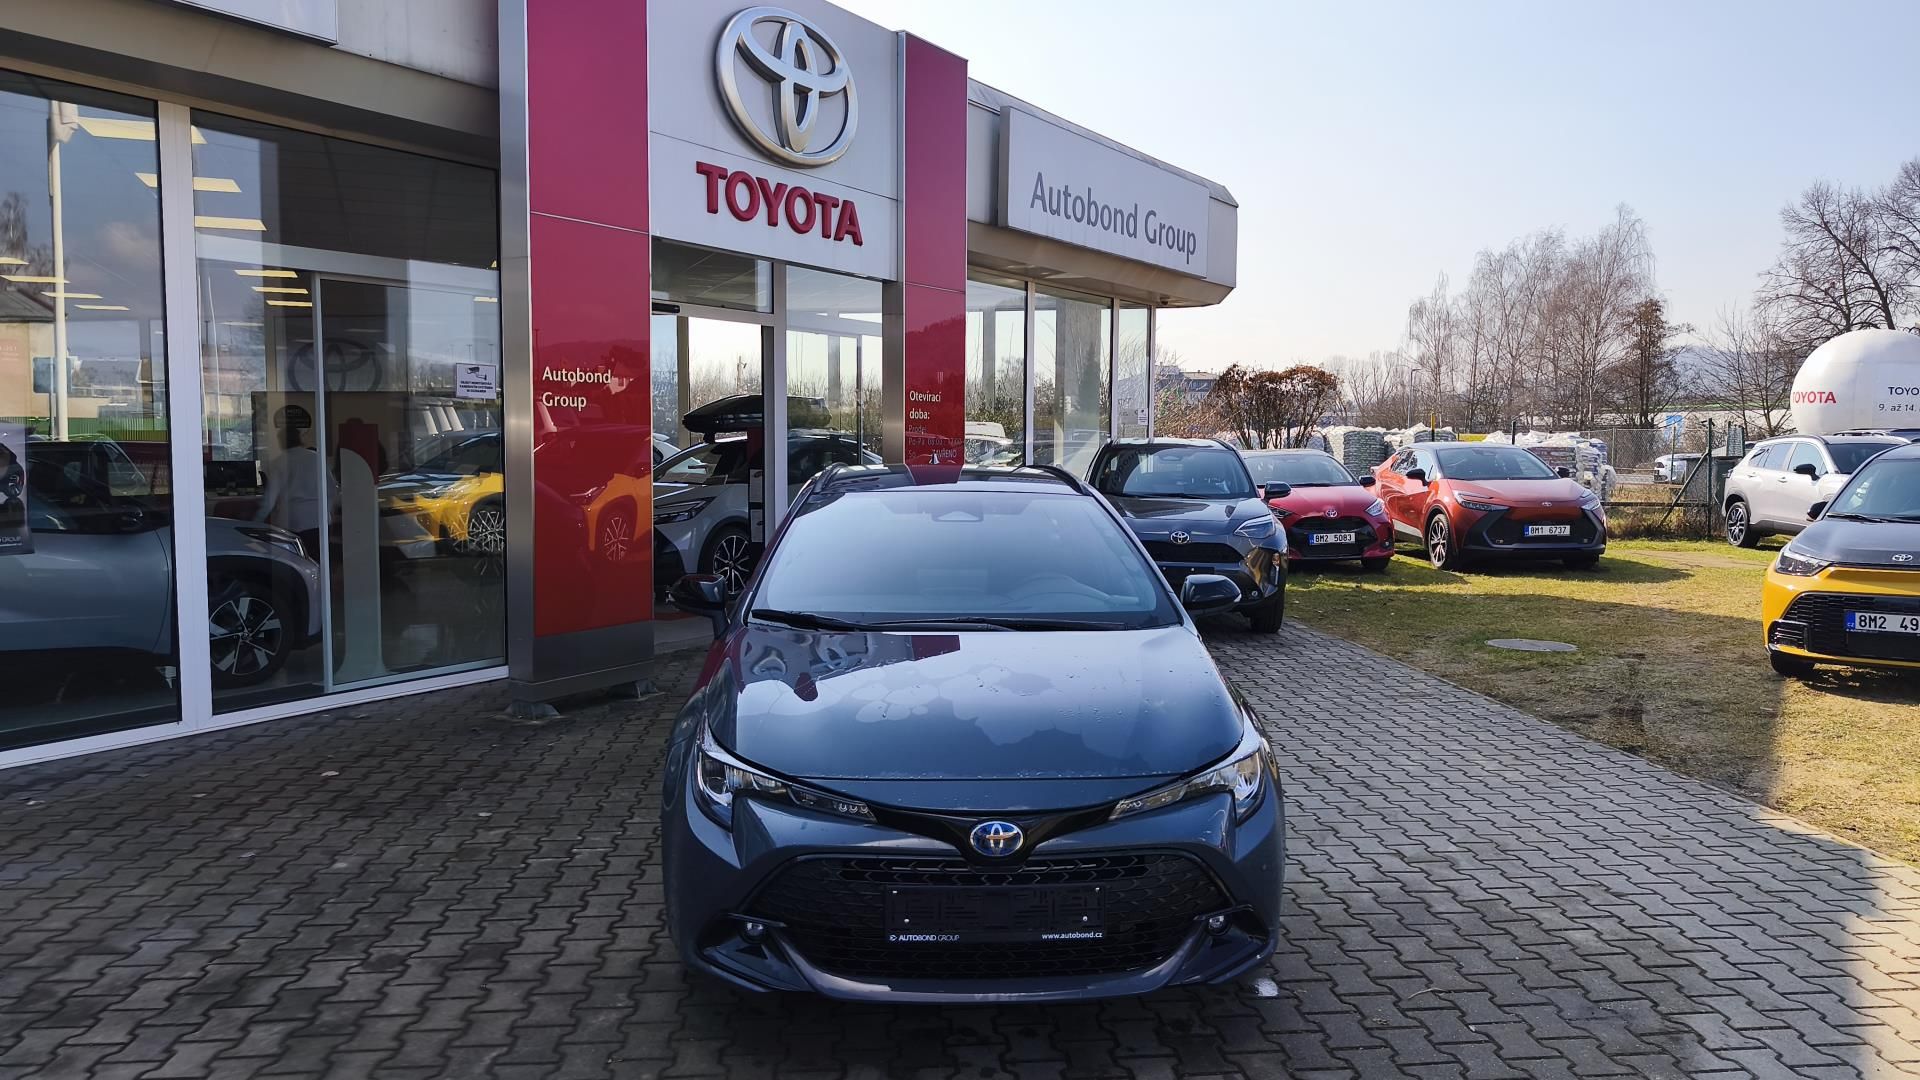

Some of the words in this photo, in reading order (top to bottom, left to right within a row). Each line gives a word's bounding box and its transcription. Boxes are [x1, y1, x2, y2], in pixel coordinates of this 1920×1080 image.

[696, 161, 863, 246] TOYOTA
[1030, 171, 1138, 239] Autobond
[1144, 210, 1197, 265] Group
[542, 366, 611, 384] Autobond
[542, 391, 587, 412] Group
[909, 390, 942, 402] Otevírací
[1792, 391, 1837, 404] TOYOTA
[909, 407, 931, 420] doba:
[1890, 404, 1902, 412] až
[1530, 526, 1544, 535] 8M1
[1548, 526, 1567, 534] 6737
[1858, 614, 1887, 629] 8M2
[1899, 617, 1920, 631] 49
[1041, 931, 1103, 939] www.autobond.cz
